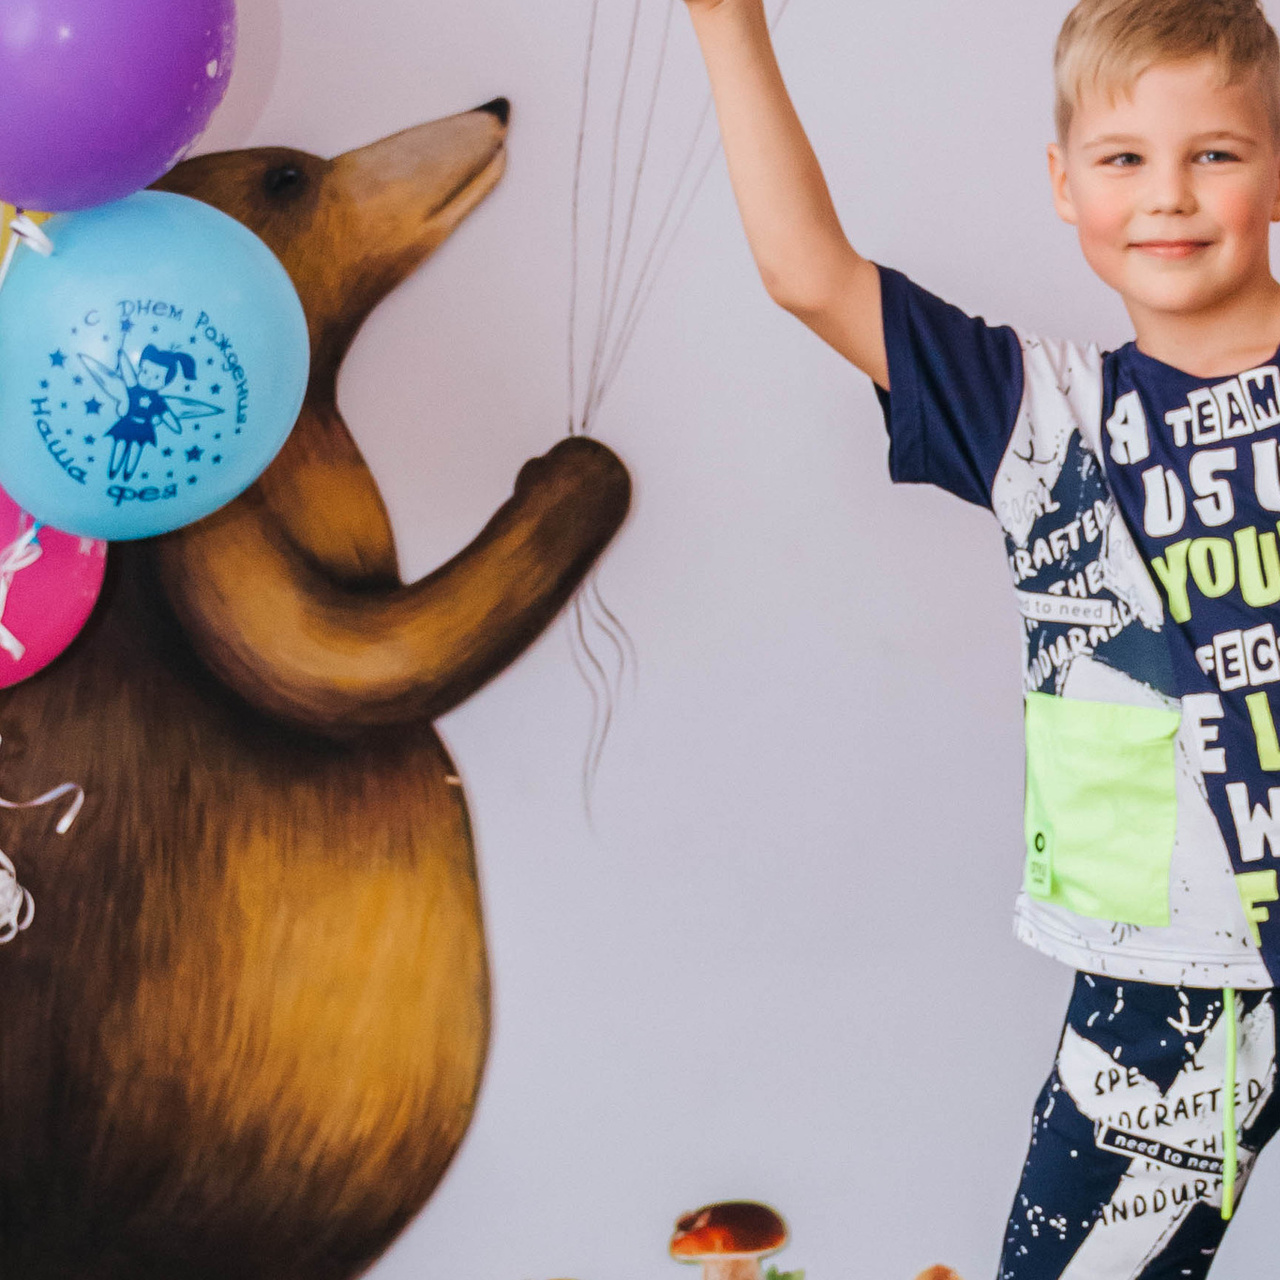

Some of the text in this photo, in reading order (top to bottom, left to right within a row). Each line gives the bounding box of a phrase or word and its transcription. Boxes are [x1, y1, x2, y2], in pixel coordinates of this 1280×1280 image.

[1008, 500, 1112, 585] RAFTED
[1059, 602, 1103, 619] need
[1114, 1135, 1159, 1157] need
[1163, 1148, 1183, 1164] to
